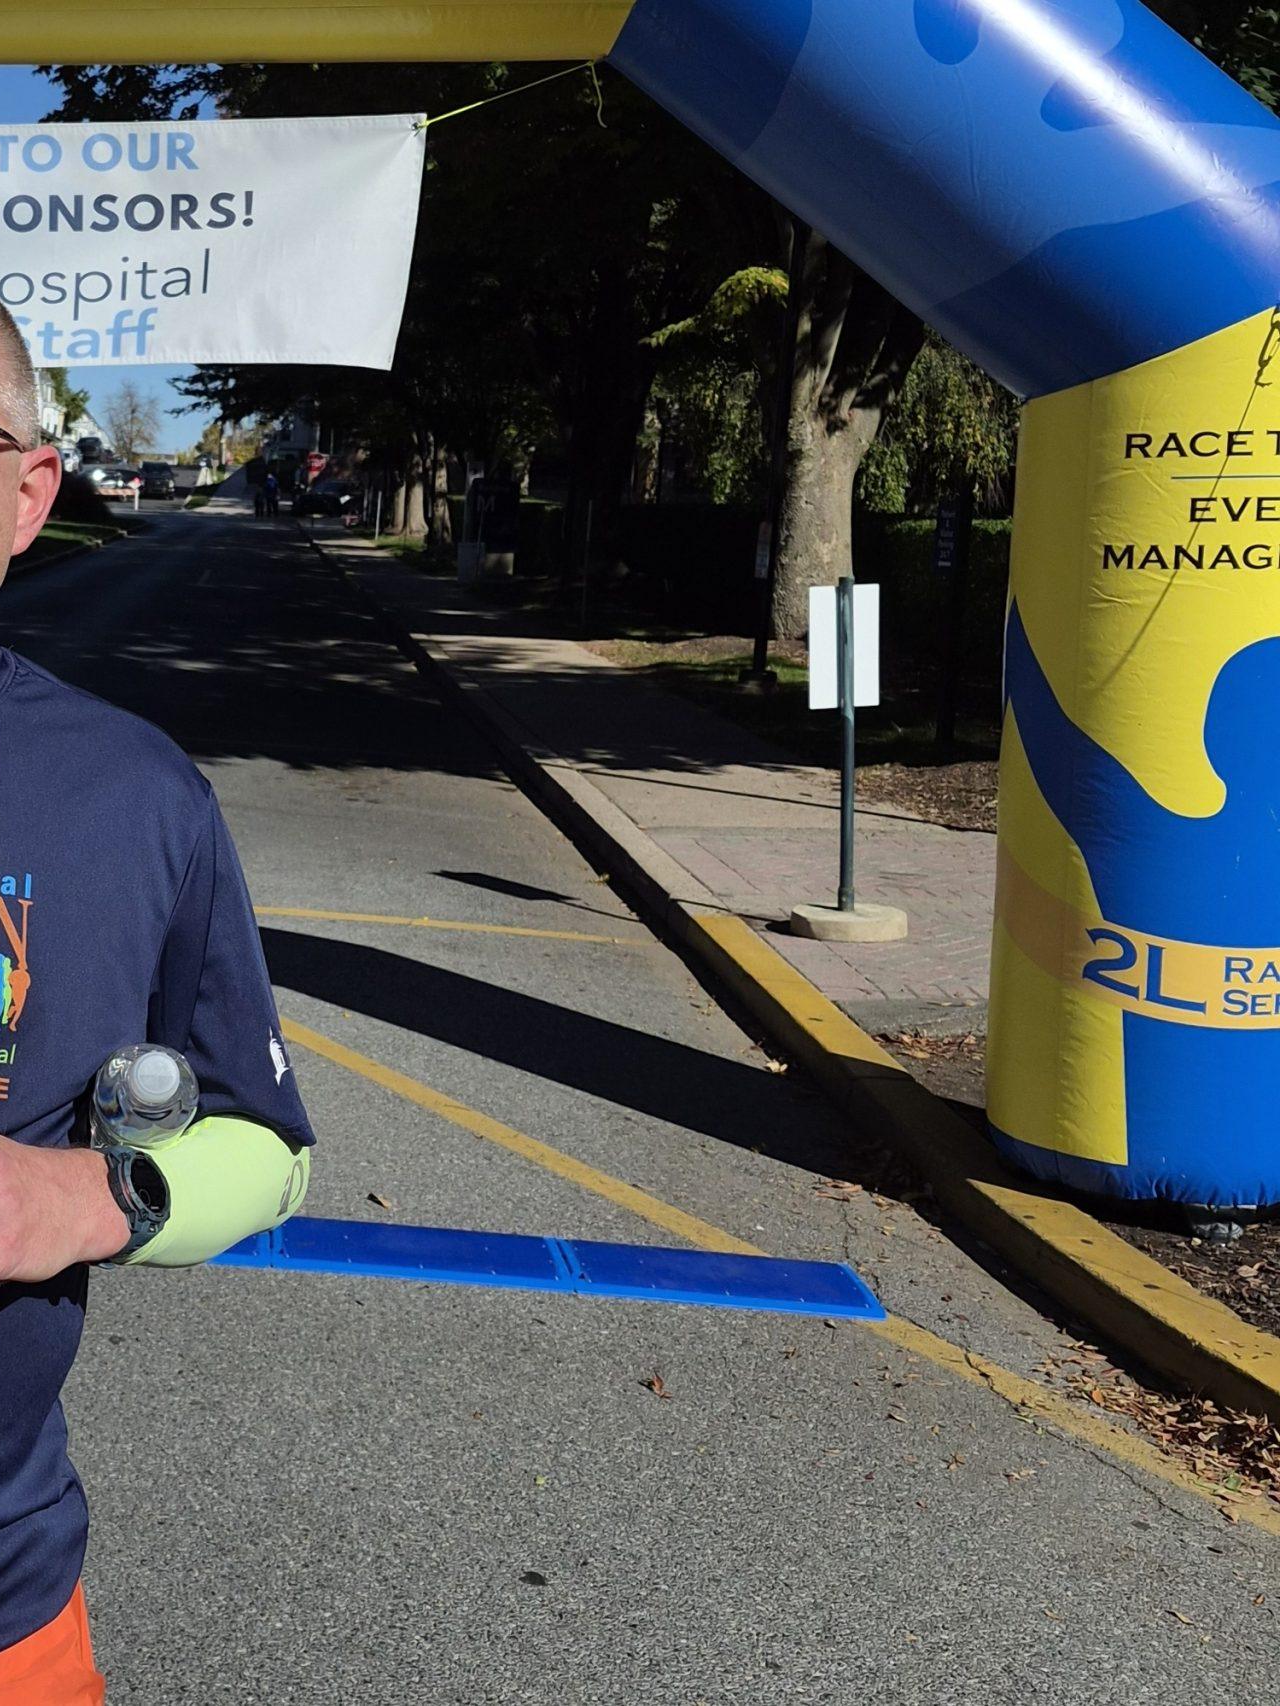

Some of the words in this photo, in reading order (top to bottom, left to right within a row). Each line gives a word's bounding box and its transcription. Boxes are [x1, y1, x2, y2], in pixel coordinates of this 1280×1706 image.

[81, 132, 200, 172] OUR
[1124, 430, 1254, 459] RACE
[1188, 496, 1280, 523] EVE
[1102, 544, 1280, 570] MANAG
[1082, 927, 1207, 1015] 2L
[1222, 989, 1280, 1016] SE
